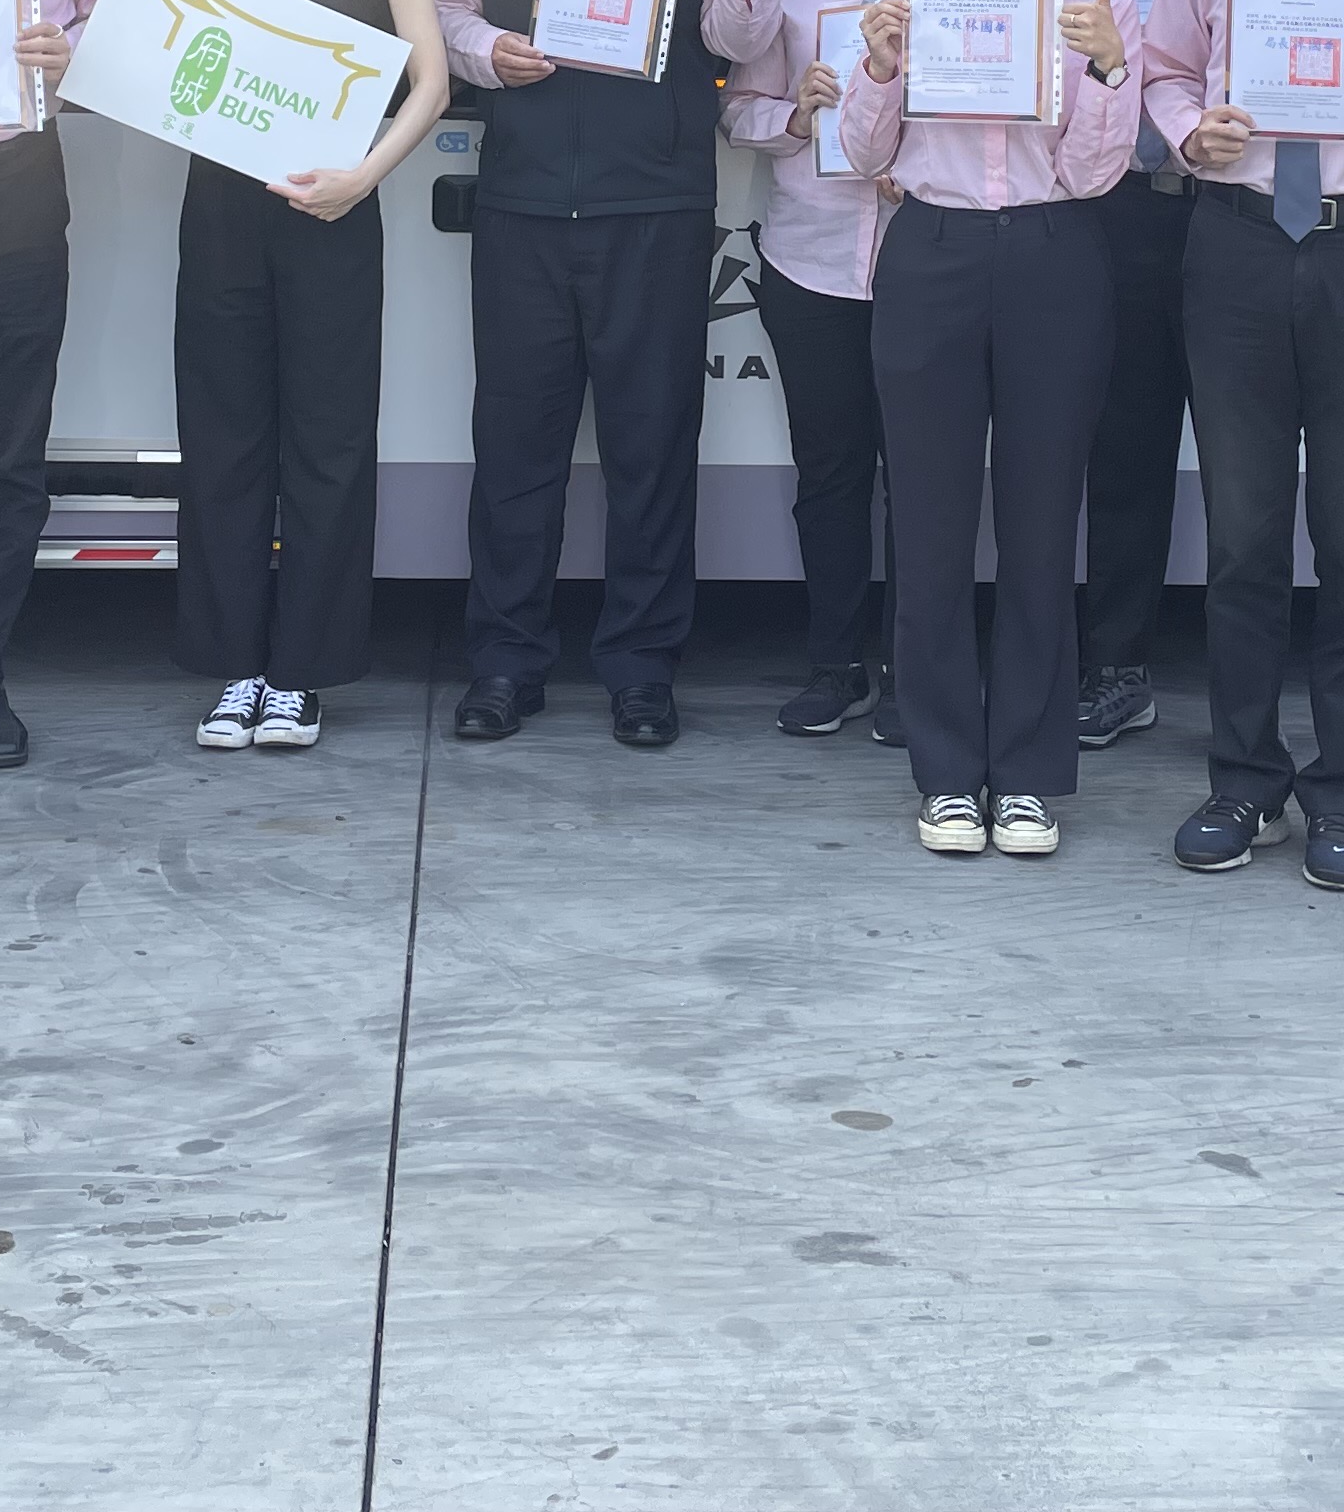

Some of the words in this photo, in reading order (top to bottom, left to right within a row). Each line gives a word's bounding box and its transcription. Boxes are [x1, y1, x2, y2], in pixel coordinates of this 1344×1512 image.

[938, 16, 1006, 35] 局長林國華
[170, 31, 231, 115] 府城
[234, 67, 321, 120] TAINAN
[160, 113, 196, 140] 客運
[217, 94, 275, 133] BUS
